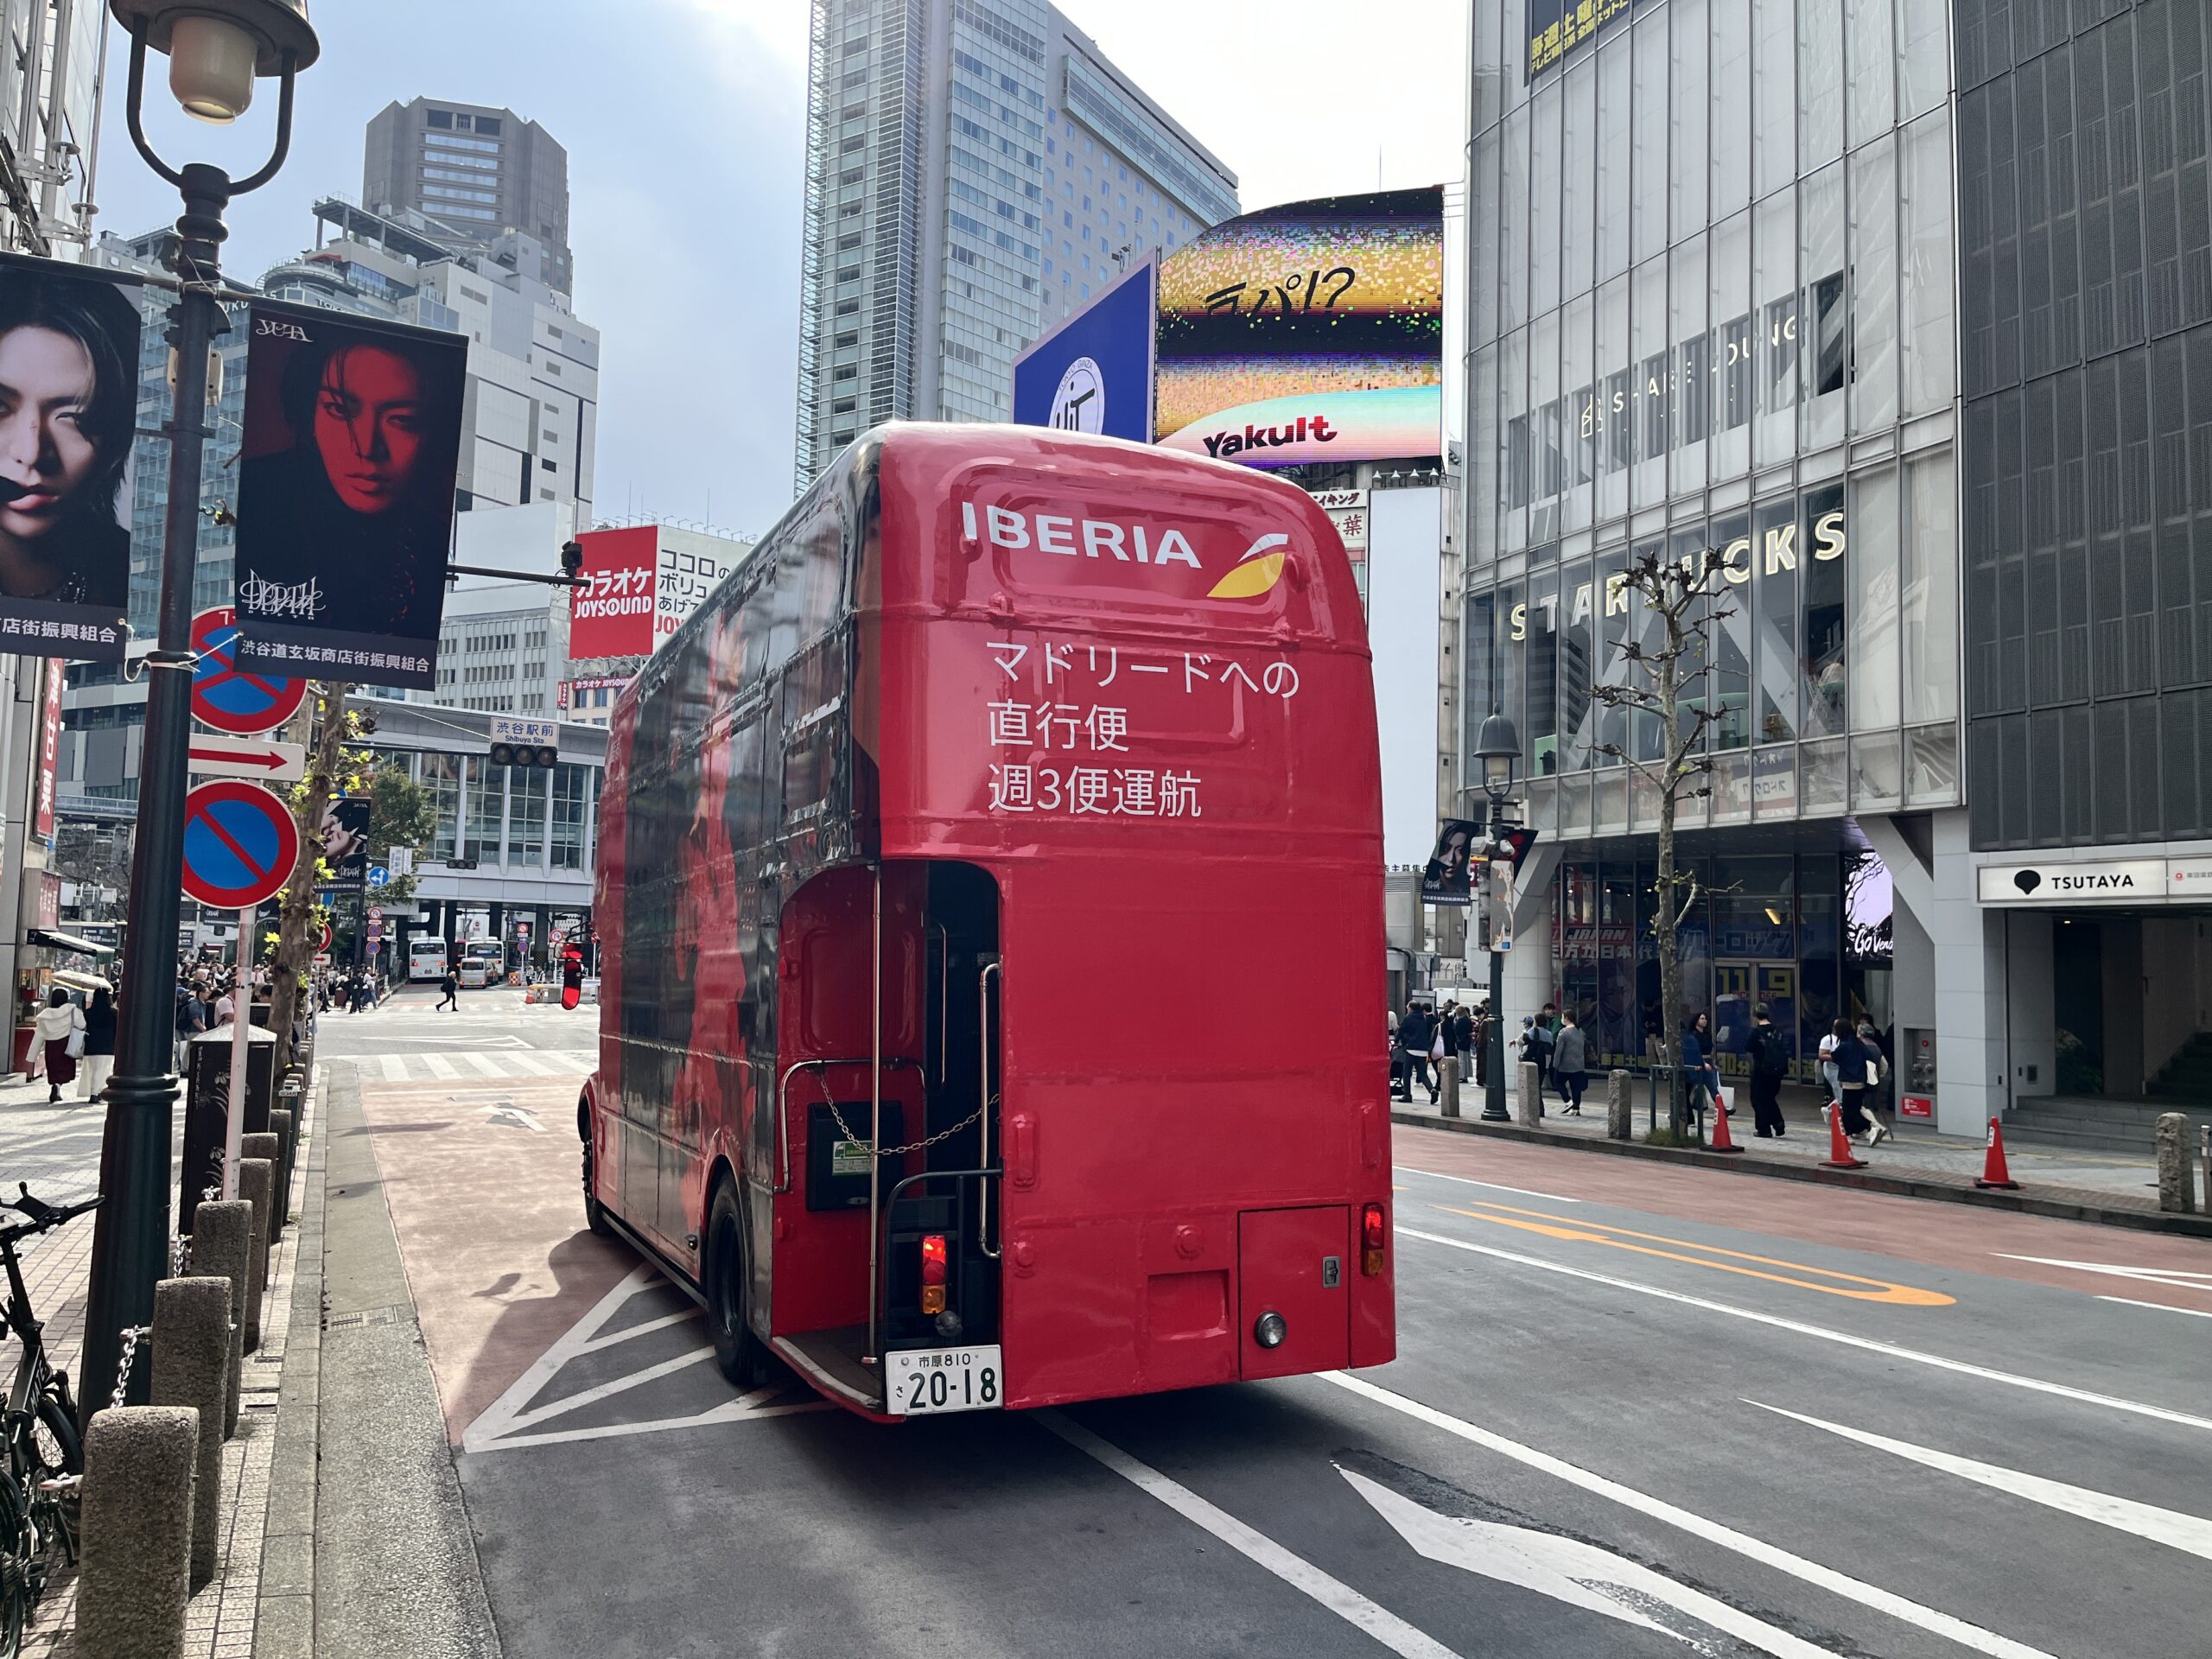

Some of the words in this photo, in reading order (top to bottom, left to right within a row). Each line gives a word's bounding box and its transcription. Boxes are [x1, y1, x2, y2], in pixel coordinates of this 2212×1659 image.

[1202, 416, 1338, 461] Yakult
[1314, 491, 1360, 506] イキング
[962, 500, 1203, 569] IBERIA
[575, 566, 653, 599] カラオケ
[574, 595, 653, 619] JOYSOUND
[0, 617, 118, 644] 店街振興組合
[240, 639, 431, 673] 渋谷道玄坂商店街振興組合
[986, 639, 1300, 700] マドリードへの
[575, 679, 601, 690] カラオケ
[497, 721, 554, 737] 渋谷駅前
[505, 734, 531, 745] Shibuya
[987, 698, 1129, 753] 直行便
[988, 763, 1202, 817] 週3便運航
[2051, 874, 2133, 889] TSUTAYA
[895, 1385, 904, 1398] さ
[908, 1367, 996, 1409] 20-18
